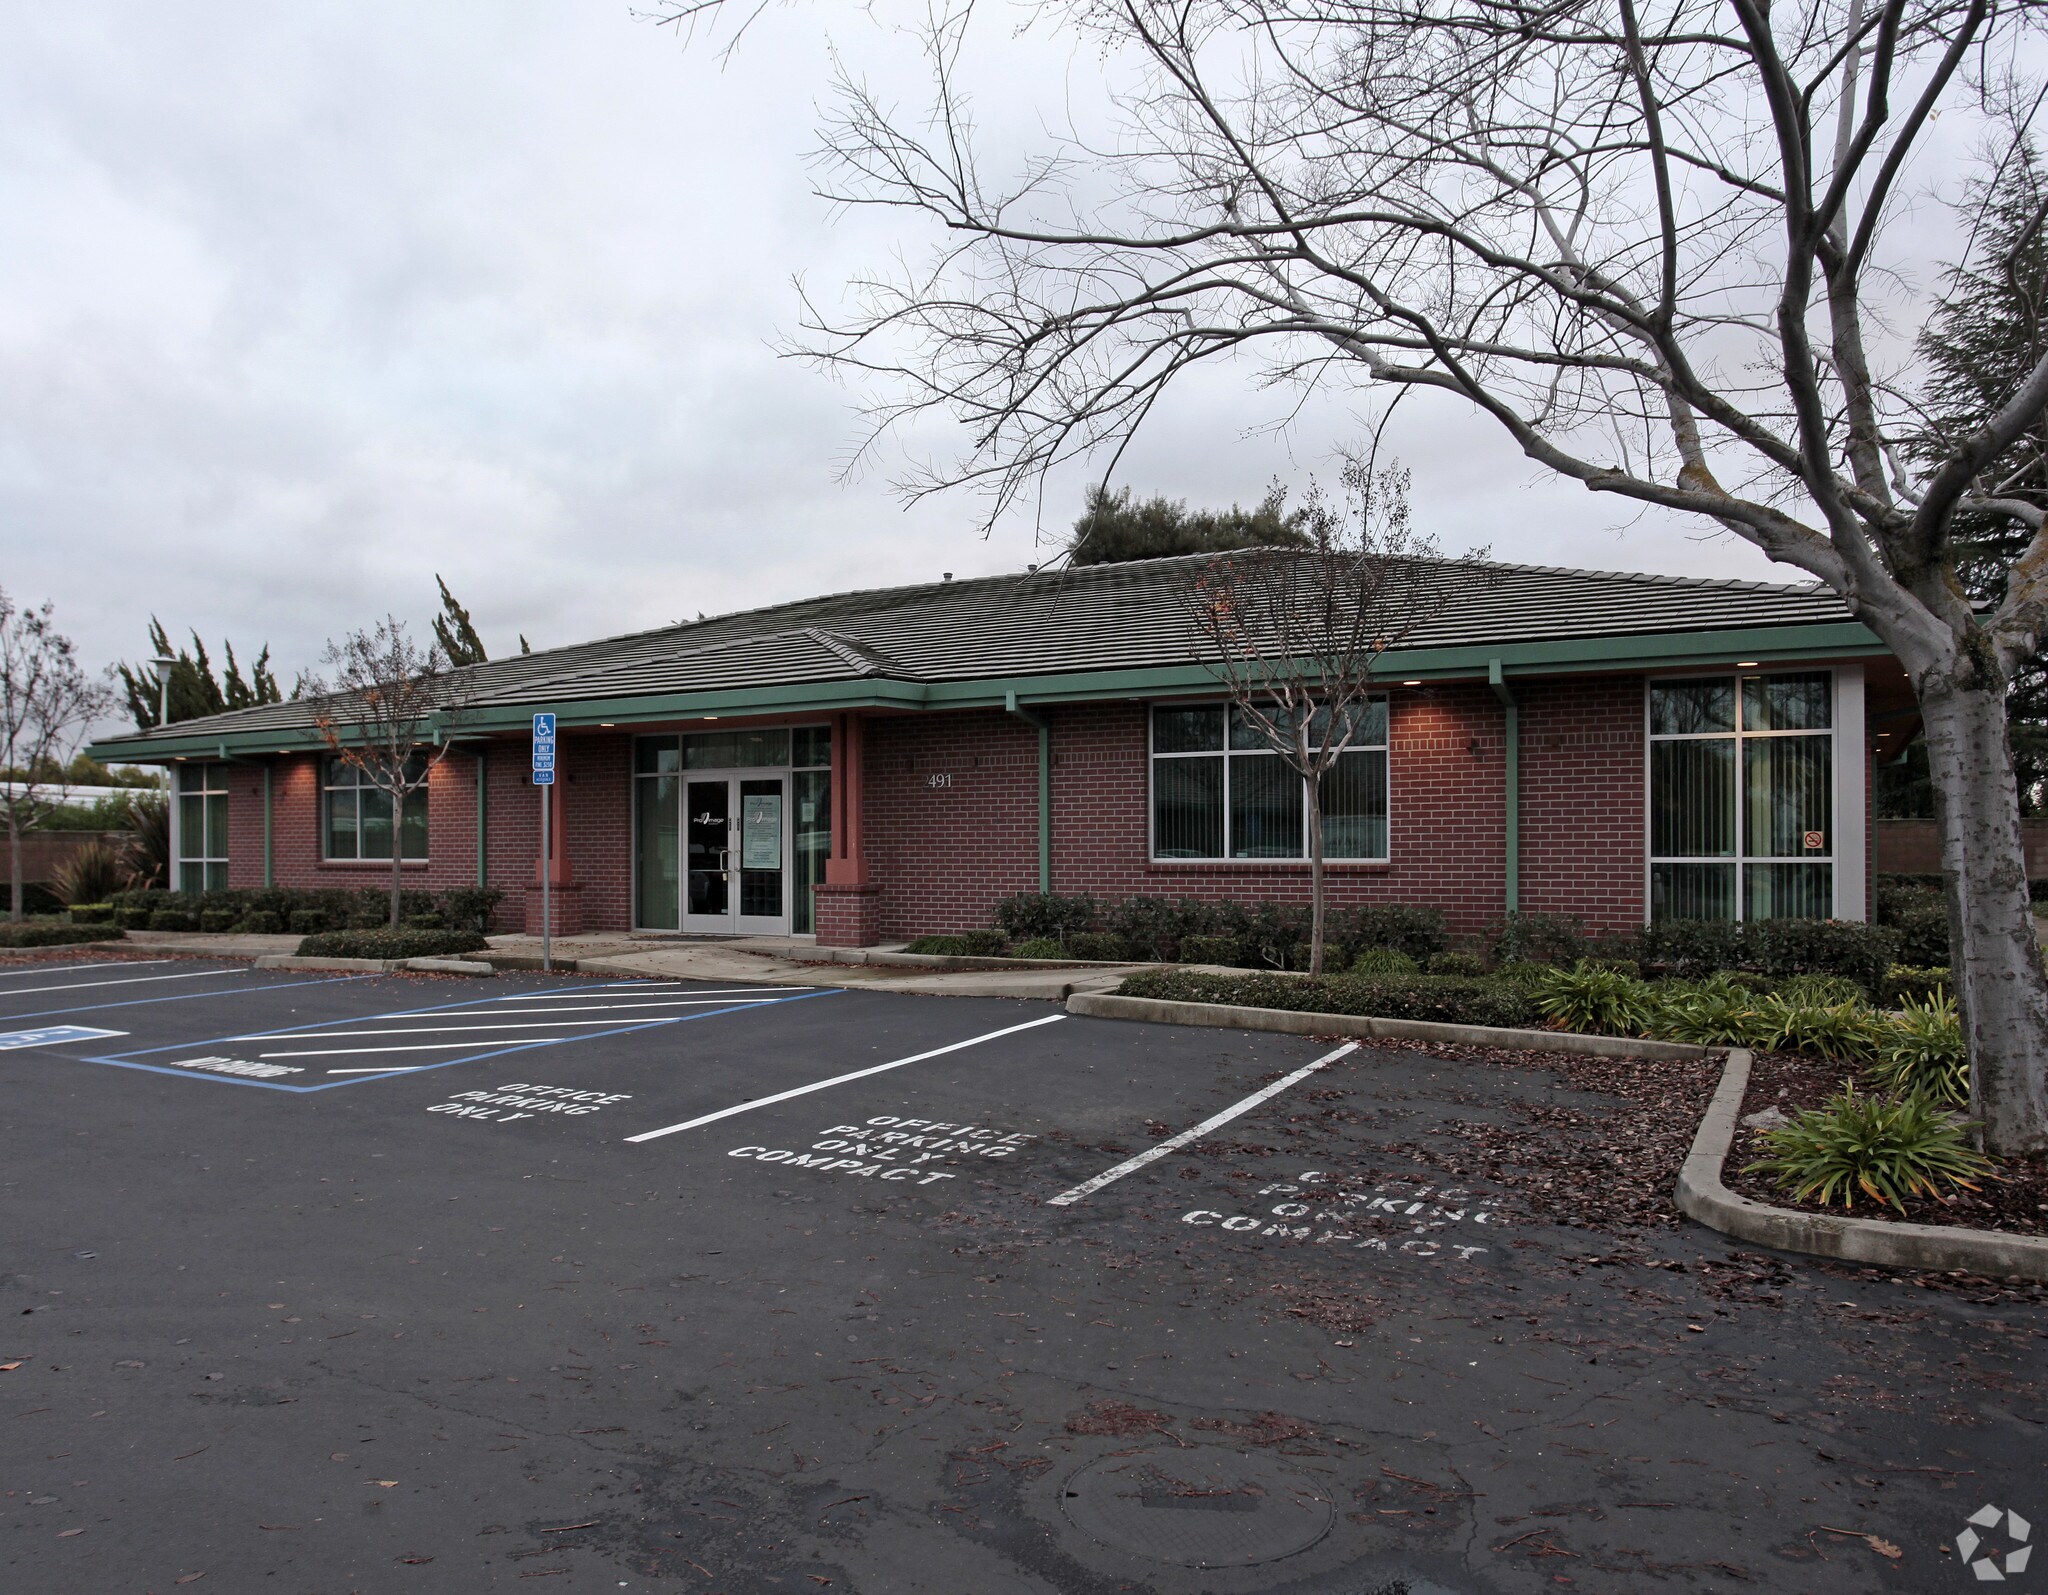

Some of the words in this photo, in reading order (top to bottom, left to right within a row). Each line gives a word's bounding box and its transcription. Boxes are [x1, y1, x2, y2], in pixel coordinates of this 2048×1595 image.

[535, 736, 554, 744] PARKING
[538, 745, 550, 753] ONLY
[169, 1056, 232, 1068] NO
[197, 1060, 305, 1078] PARKING
[448, 1091, 600, 1115] PARKING
[497, 1083, 633, 1105] OFFICE
[426, 1103, 535, 1122] ONLY
[819, 1125, 1016, 1157] PARKING
[866, 1116, 1037, 1145] OFFICE
[811, 1139, 946, 1164] ONLY
[727, 1146, 957, 1185] COMPACT
